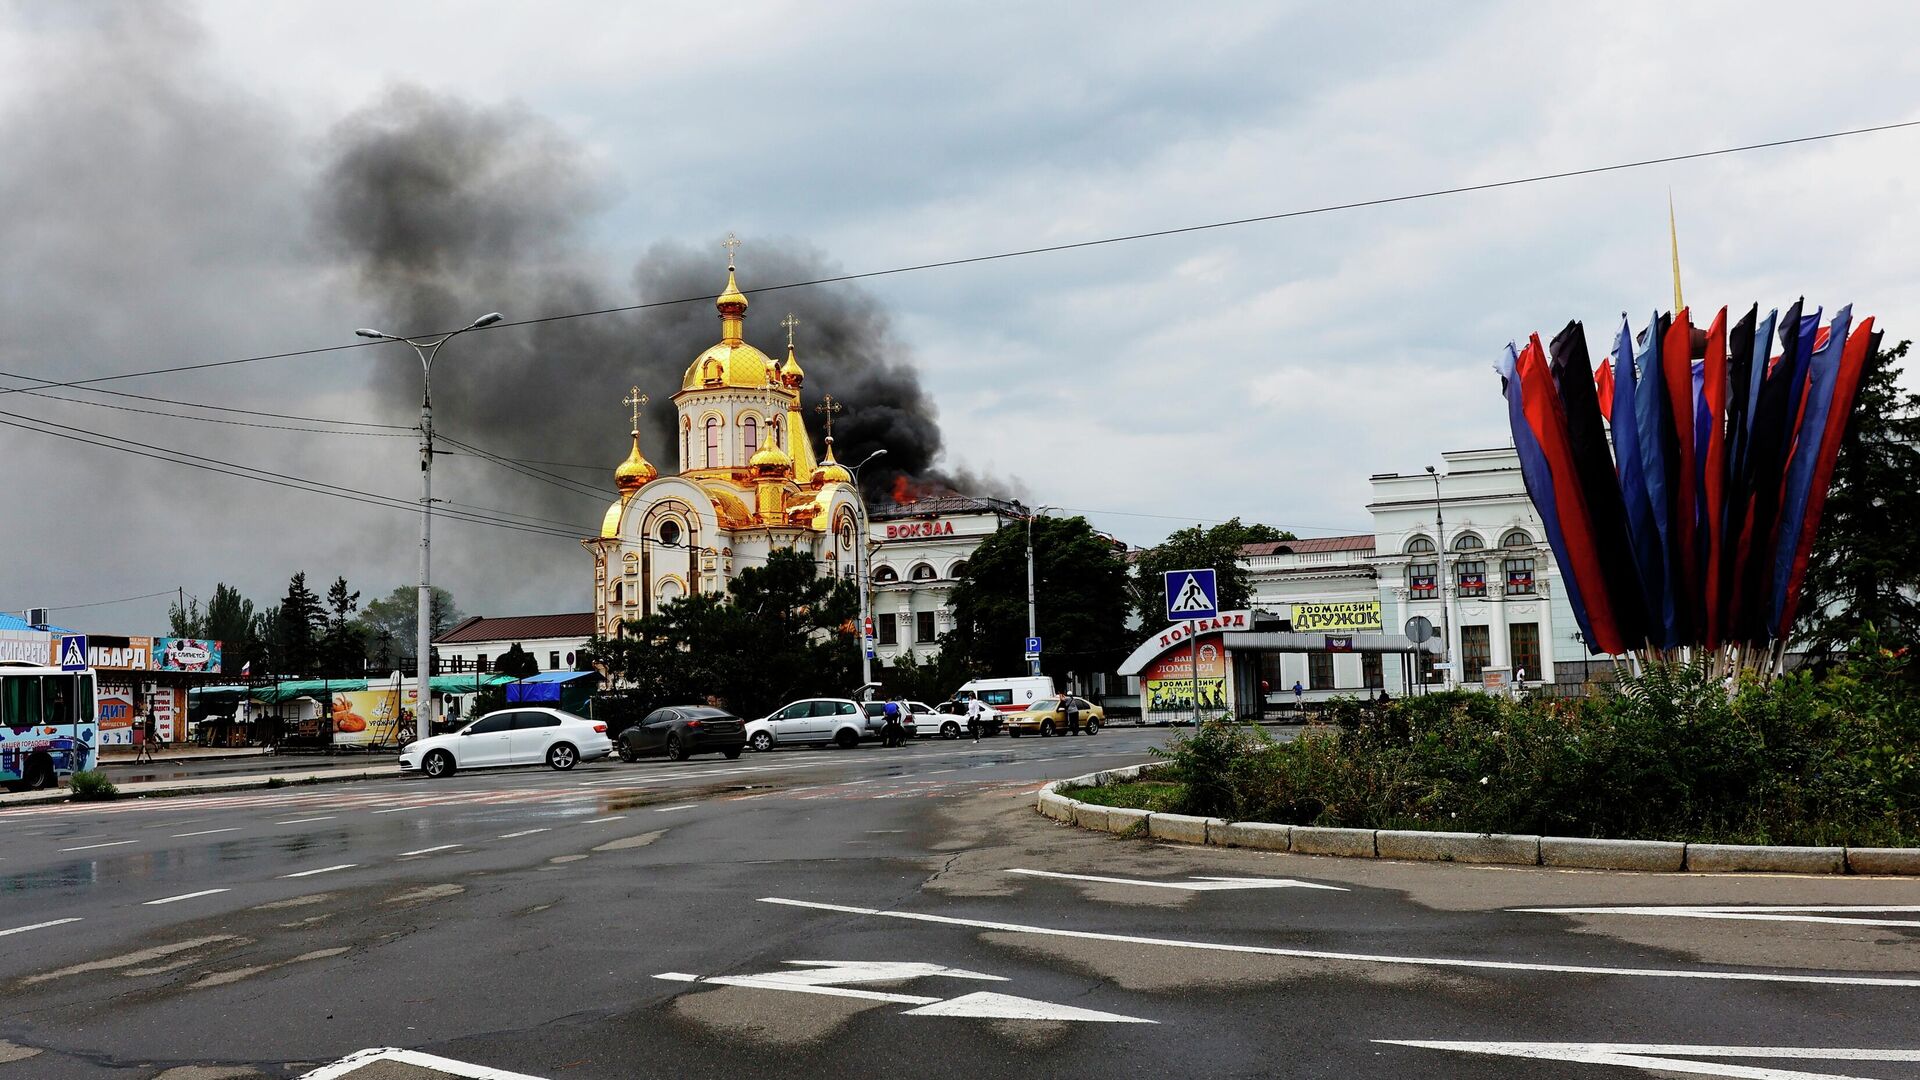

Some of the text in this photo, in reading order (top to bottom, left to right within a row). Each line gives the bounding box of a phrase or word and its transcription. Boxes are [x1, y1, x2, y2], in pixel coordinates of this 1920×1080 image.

[886, 521, 954, 539] ВОКЗАЛ
[1300, 604, 1373, 614] ЗООМАГАЗИН
[1294, 611, 1380, 630] ДРУЖОК
[1159, 680, 1214, 688] ЗООМАГЗИН
